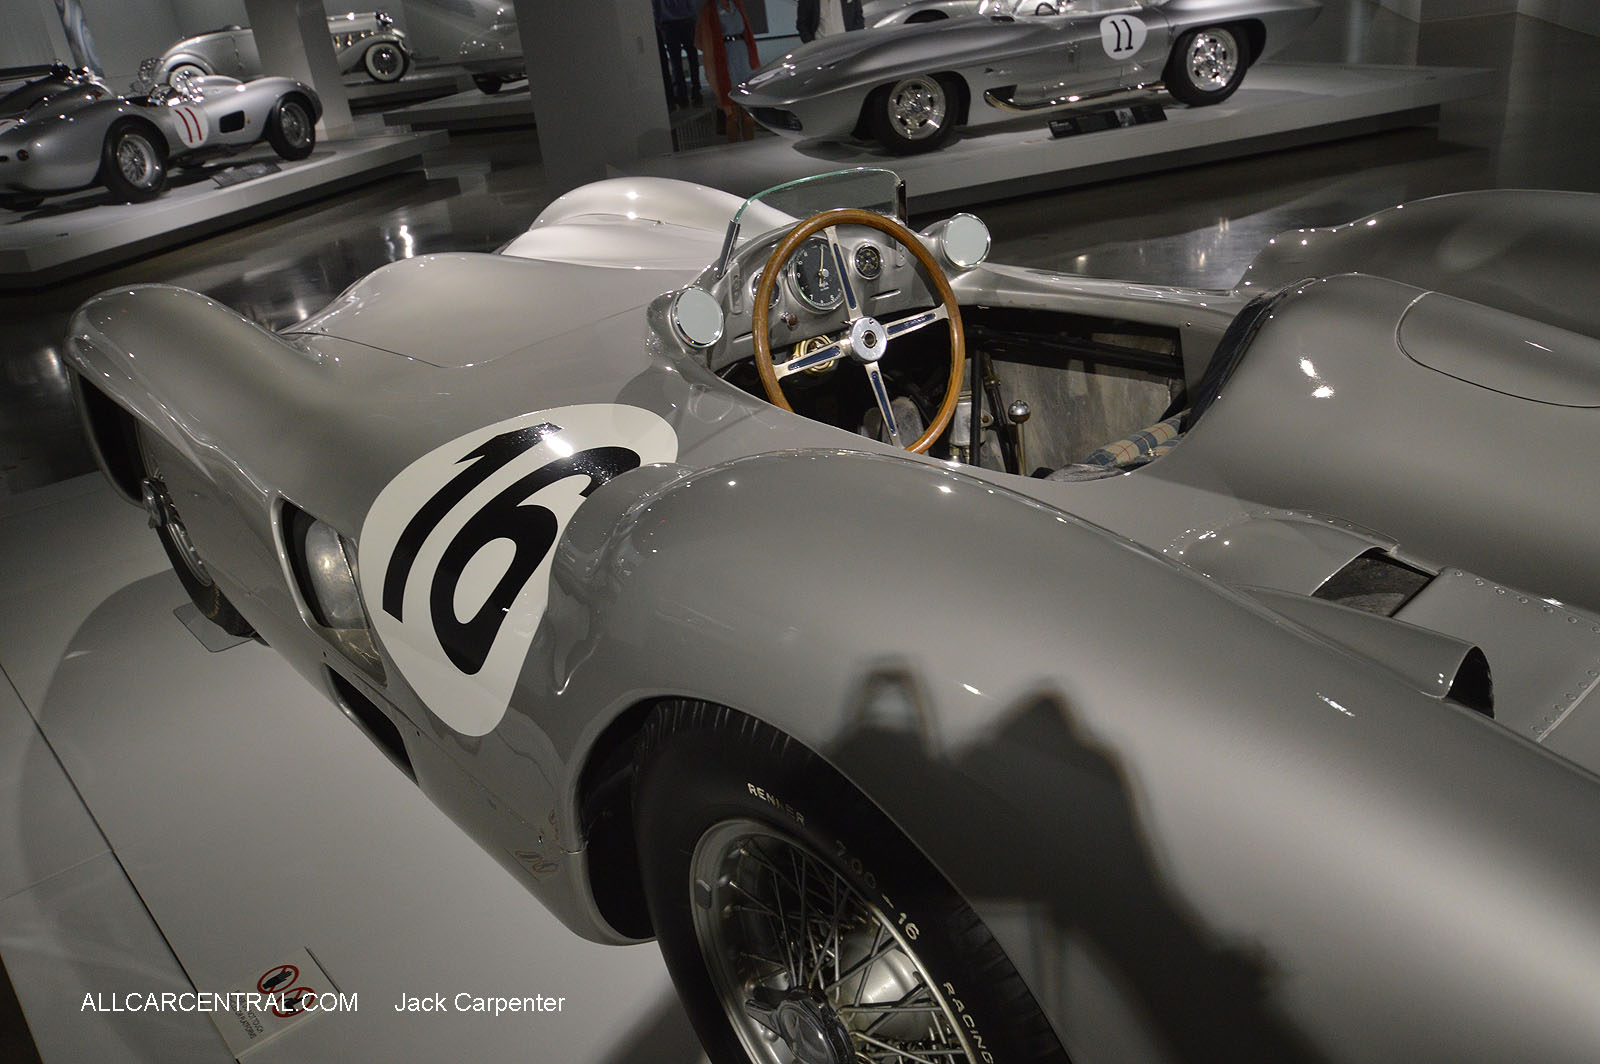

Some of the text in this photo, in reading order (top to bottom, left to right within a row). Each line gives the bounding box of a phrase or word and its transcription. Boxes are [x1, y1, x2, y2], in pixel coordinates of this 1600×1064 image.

[1109, 18, 1134, 53] 11
[174, 106, 203, 143] 11
[382, 421, 641, 675] 16
[942, 982, 994, 1064] RACING
